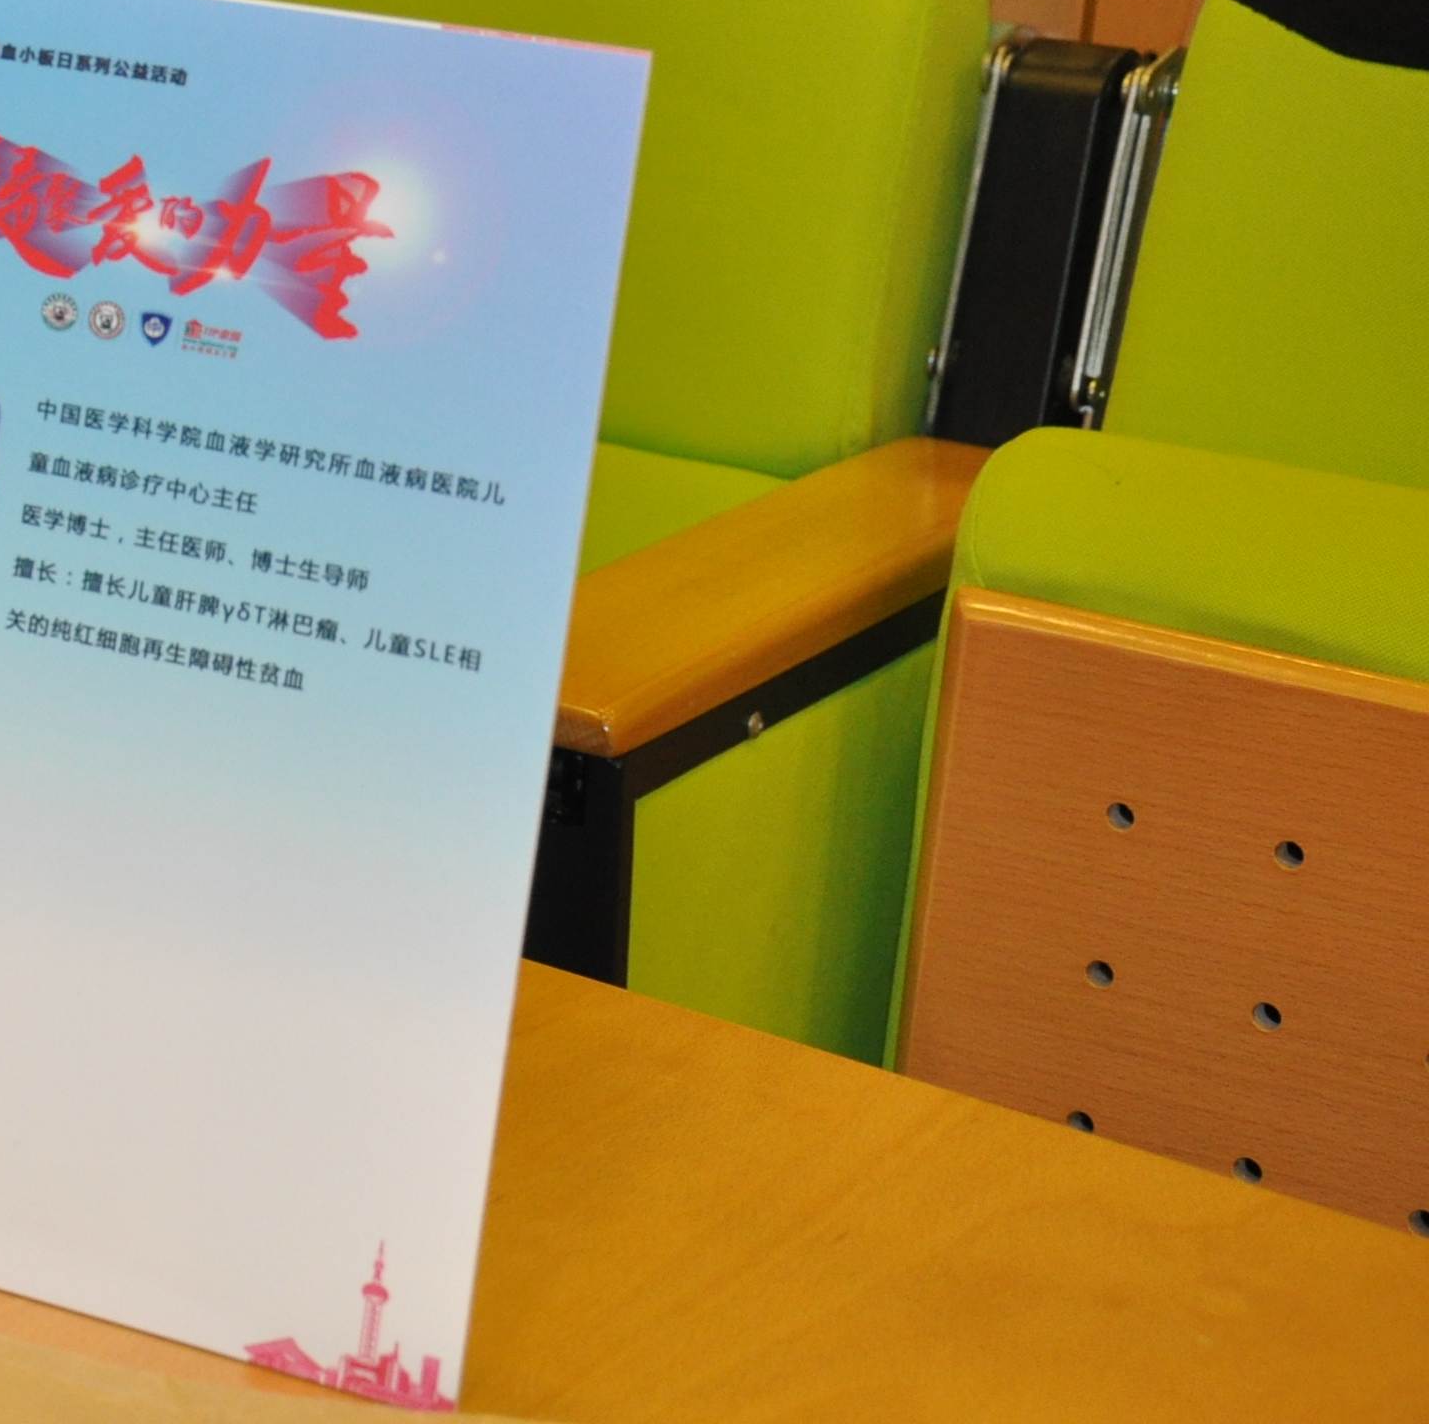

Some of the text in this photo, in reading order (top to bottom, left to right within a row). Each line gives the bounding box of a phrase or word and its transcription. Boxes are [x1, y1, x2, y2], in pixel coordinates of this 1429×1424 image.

[28, 451, 259, 515] 童血液病诊疗中心主任
[37, 398, 506, 506] 中国医学科学院血液学研究所血液病医院儿
[4, 608, 306, 691] 关的纯红细胞再生障碍性贫血
